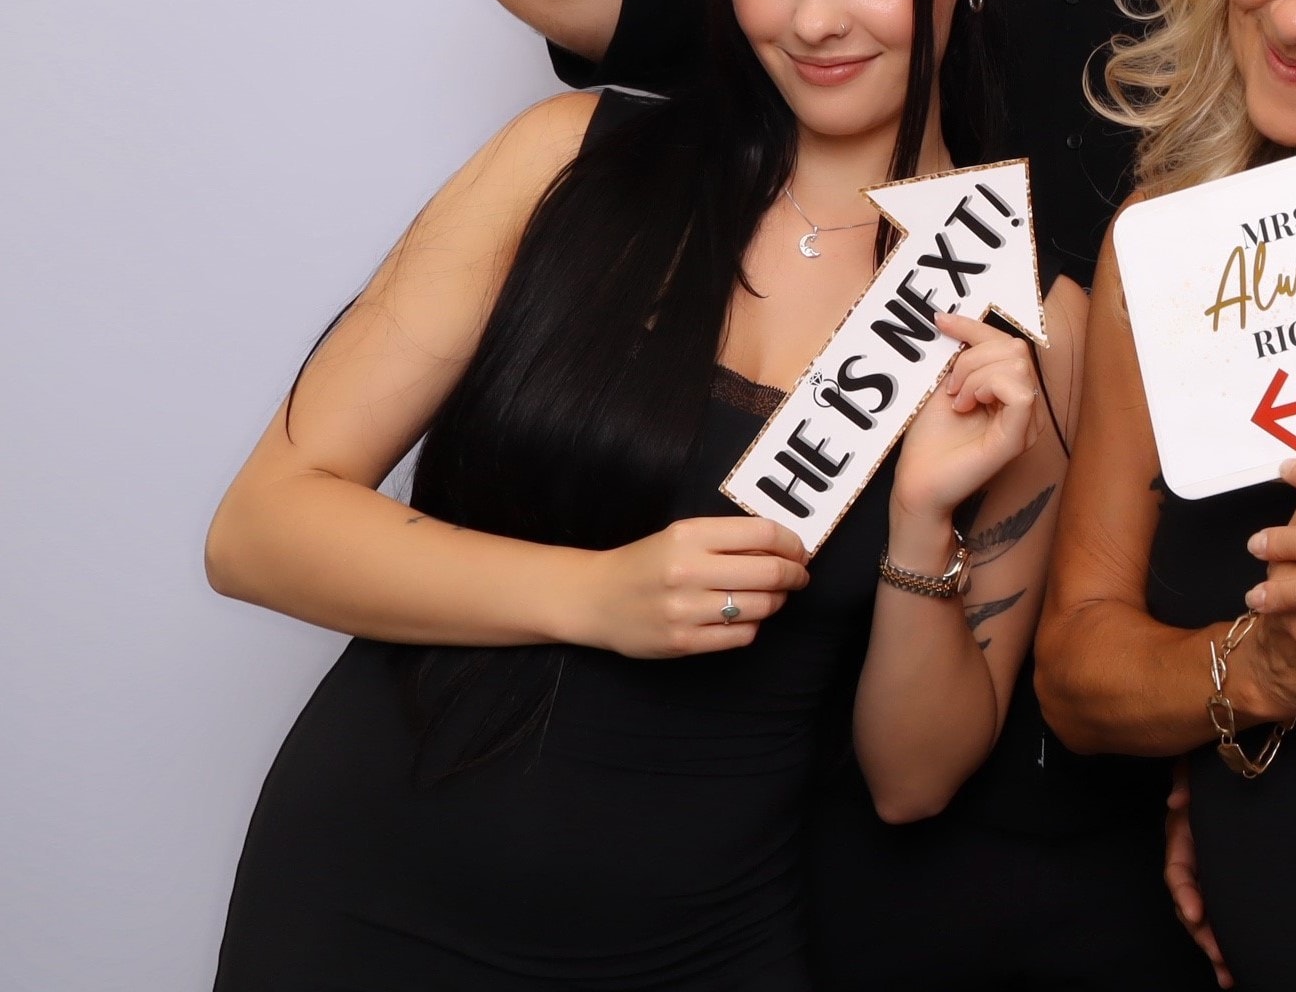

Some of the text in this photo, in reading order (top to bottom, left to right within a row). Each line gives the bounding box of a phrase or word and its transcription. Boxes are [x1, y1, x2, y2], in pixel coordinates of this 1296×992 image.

[756, 183, 1021, 519] HE IS NEXT!
